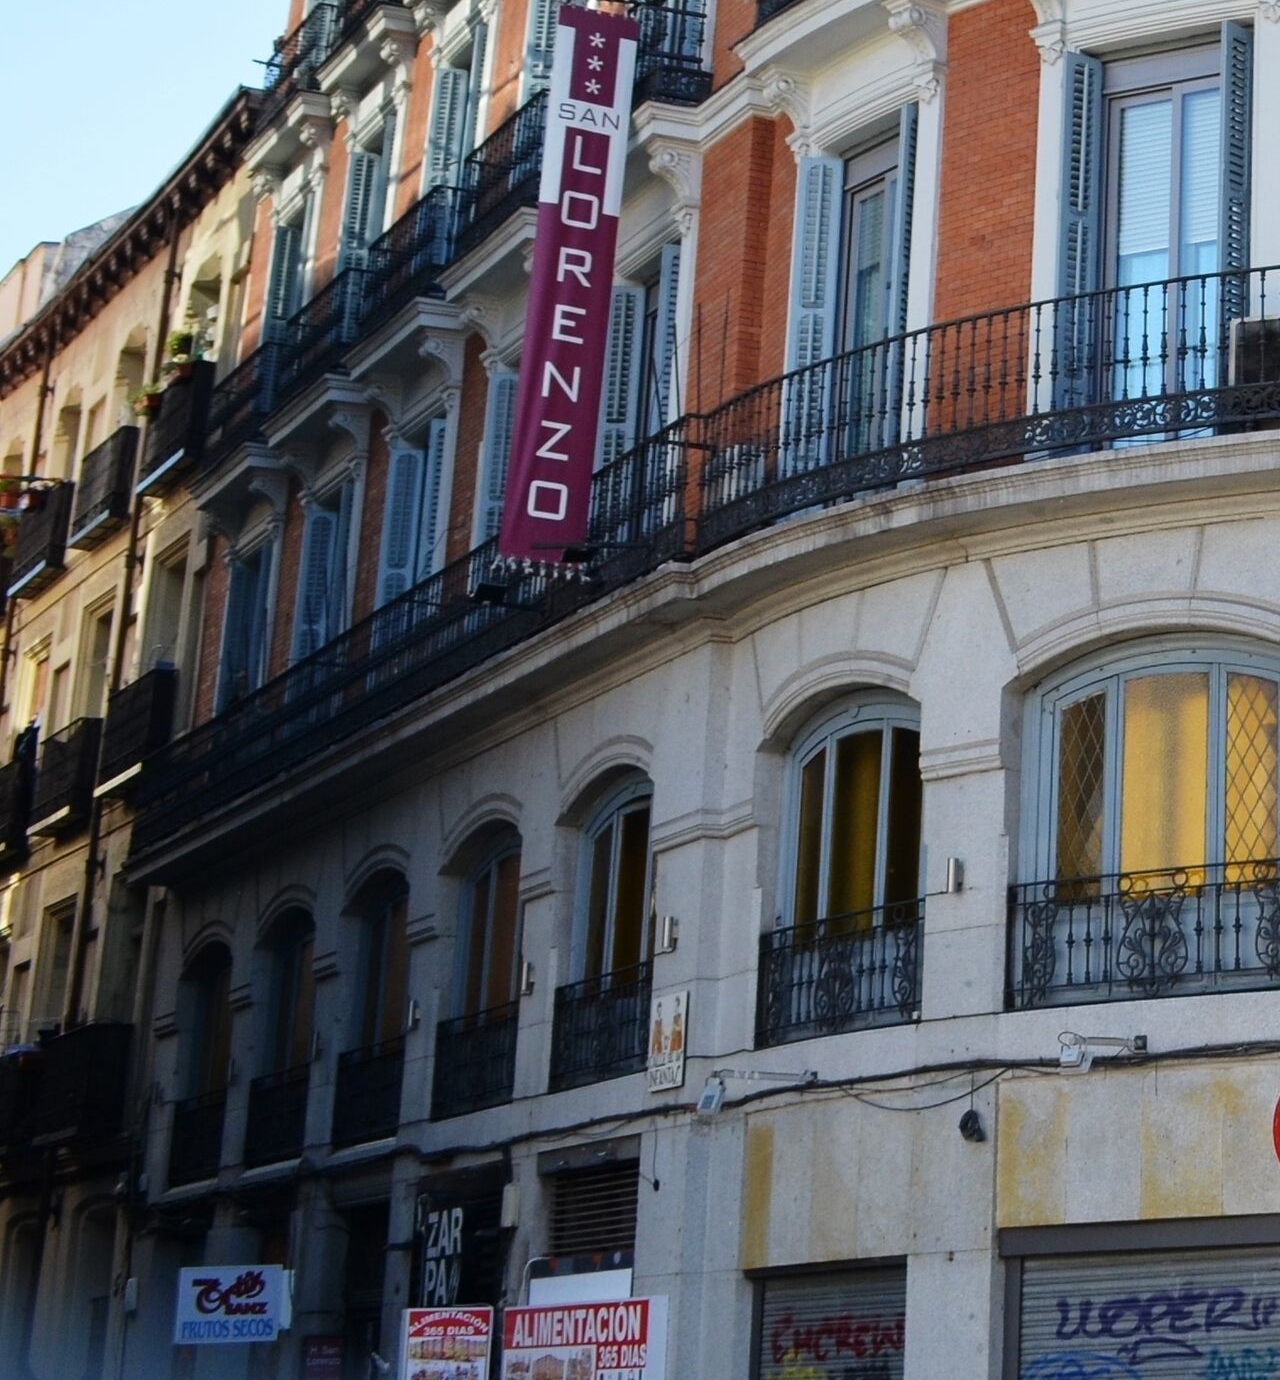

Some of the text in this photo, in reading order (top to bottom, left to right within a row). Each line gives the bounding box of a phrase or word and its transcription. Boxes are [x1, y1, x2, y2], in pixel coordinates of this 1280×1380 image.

[557, 102, 621, 131] SAN
[526, 134, 602, 522] LORENZO
[425, 1206, 464, 1259] ZAR
[181, 1317, 274, 1340] FRUTOS SECOS
[409, 1311, 489, 1335] ALIMENTACIÓN
[423, 1325, 475, 1336] 365 DIAS
[511, 1301, 642, 1348] ALIMENTACIÓN
[598, 1343, 647, 1369] 365 DIAS
